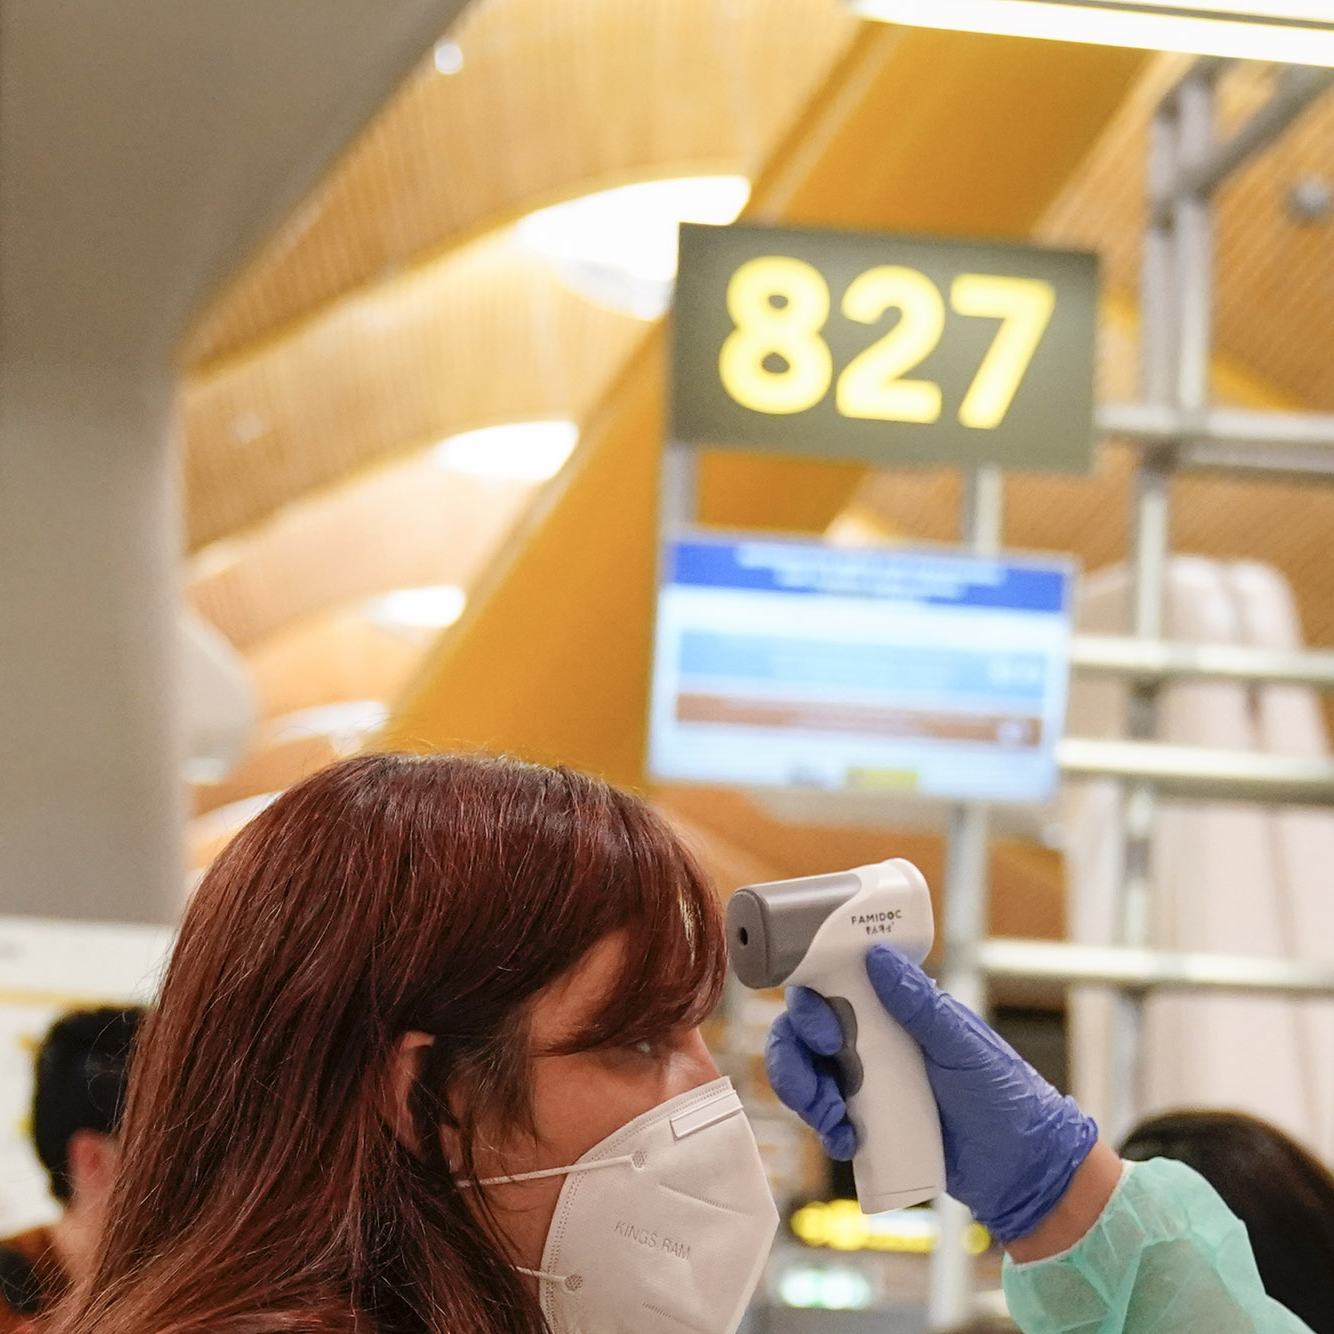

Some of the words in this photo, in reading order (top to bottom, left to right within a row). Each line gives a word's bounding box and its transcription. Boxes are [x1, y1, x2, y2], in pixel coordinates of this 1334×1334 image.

[718, 255, 1056, 430] 827
[851, 909, 903, 925] FAMIDOC
[613, 1220, 658, 1248] KINGS
[661, 1236, 692, 1261] RAM
